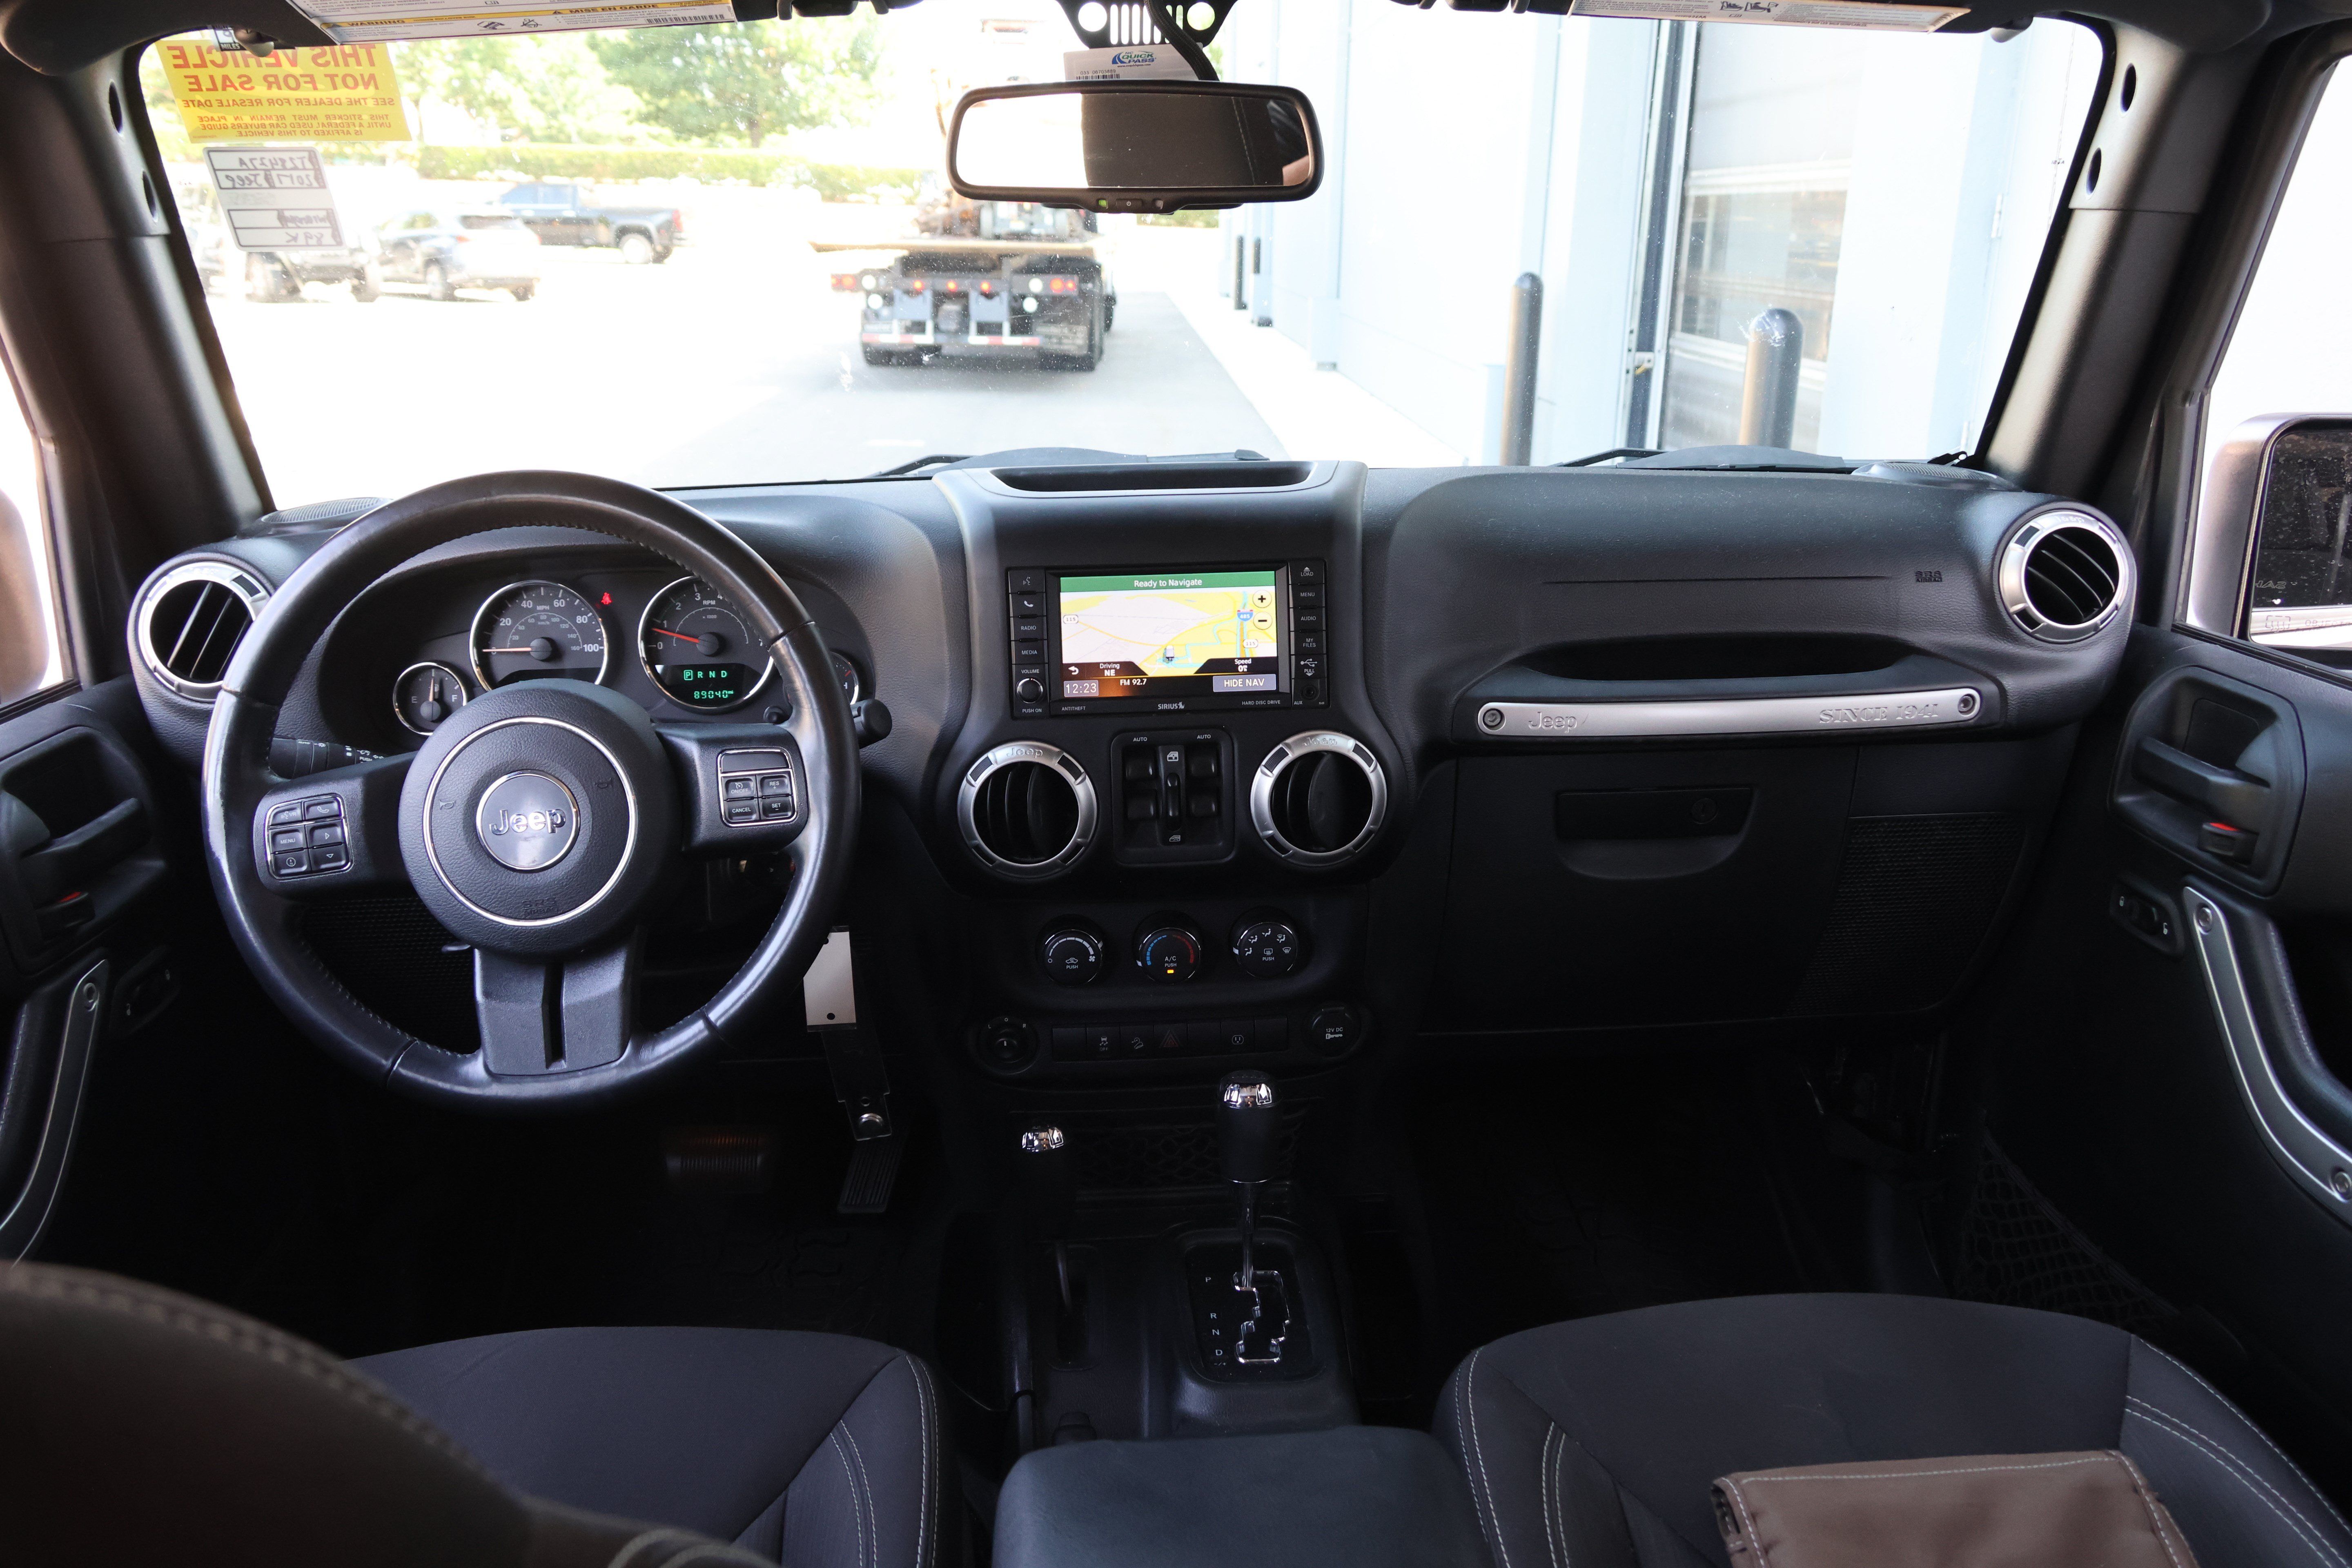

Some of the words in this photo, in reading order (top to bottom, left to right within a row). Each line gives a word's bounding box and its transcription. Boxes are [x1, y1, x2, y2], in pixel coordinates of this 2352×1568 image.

[1134, 579, 1158, 588] Ready
[1168, 578, 1203, 587] Navigate
[695, 592, 701, 601] 3
[521, 600, 532, 608] 40
[553, 599, 565, 607] 60
[500, 618, 512, 626] 20
[576, 615, 587, 624] 80
[662, 620, 667, 628] 1
[583, 644, 599, 652] 100
[657, 641, 663, 650] 0
[1223, 679, 1243, 687] HIDE
[1246, 678, 1265, 687] NAV
[1065, 683, 1097, 694] 12:23
[452, 694, 458, 702] F
[694, 690, 728, 699] 89040
[1820, 706, 1888, 723] SINCE
[1896, 704, 1938, 719] 1941
[1528, 711, 1577, 733] Jeep
[1304, 736, 1337, 746] Jeep
[1007, 748, 1043, 759] Jeep
[489, 808, 567, 835] Jeep
